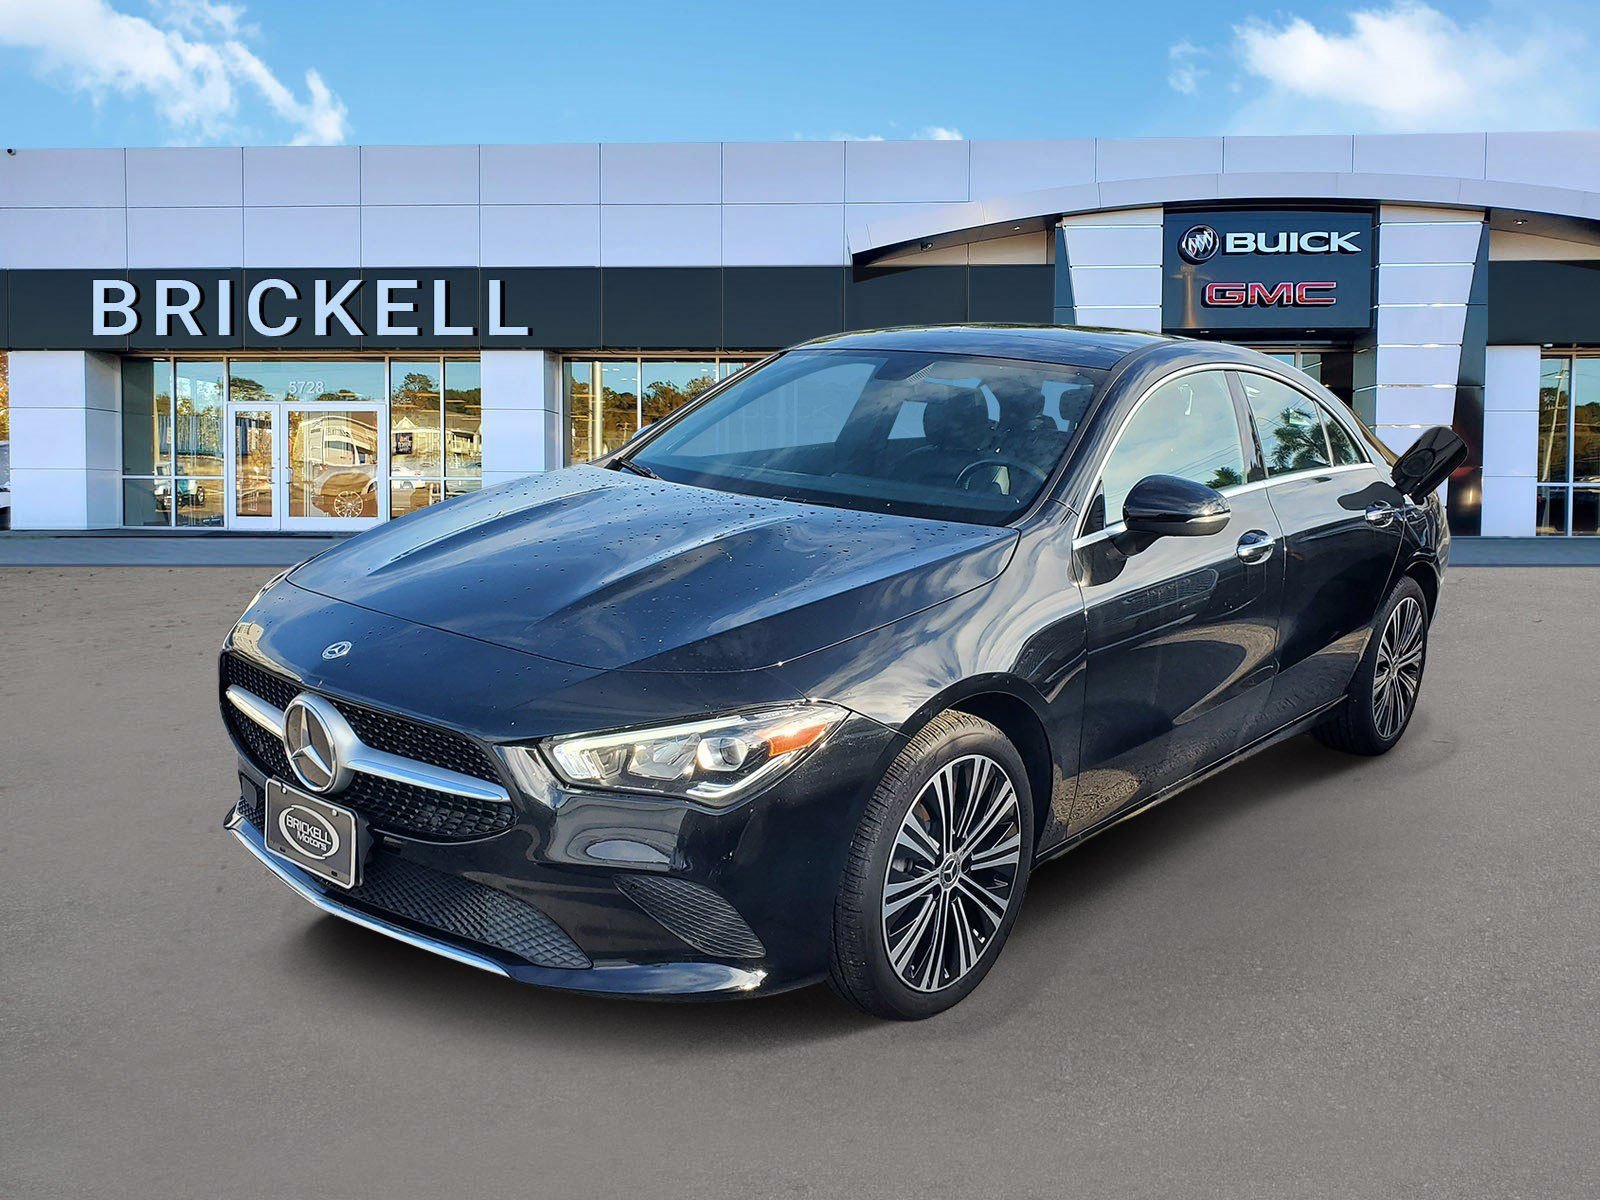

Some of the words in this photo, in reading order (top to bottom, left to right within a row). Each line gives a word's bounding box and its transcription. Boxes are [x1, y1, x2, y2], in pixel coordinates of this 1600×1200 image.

[1226, 231, 1362, 253] BUICK
[1205, 281, 1337, 305] GMC
[93, 279, 530, 337] BRICKELL
[289, 381, 325, 394] 5728
[286, 815, 332, 845] BRICKELL
